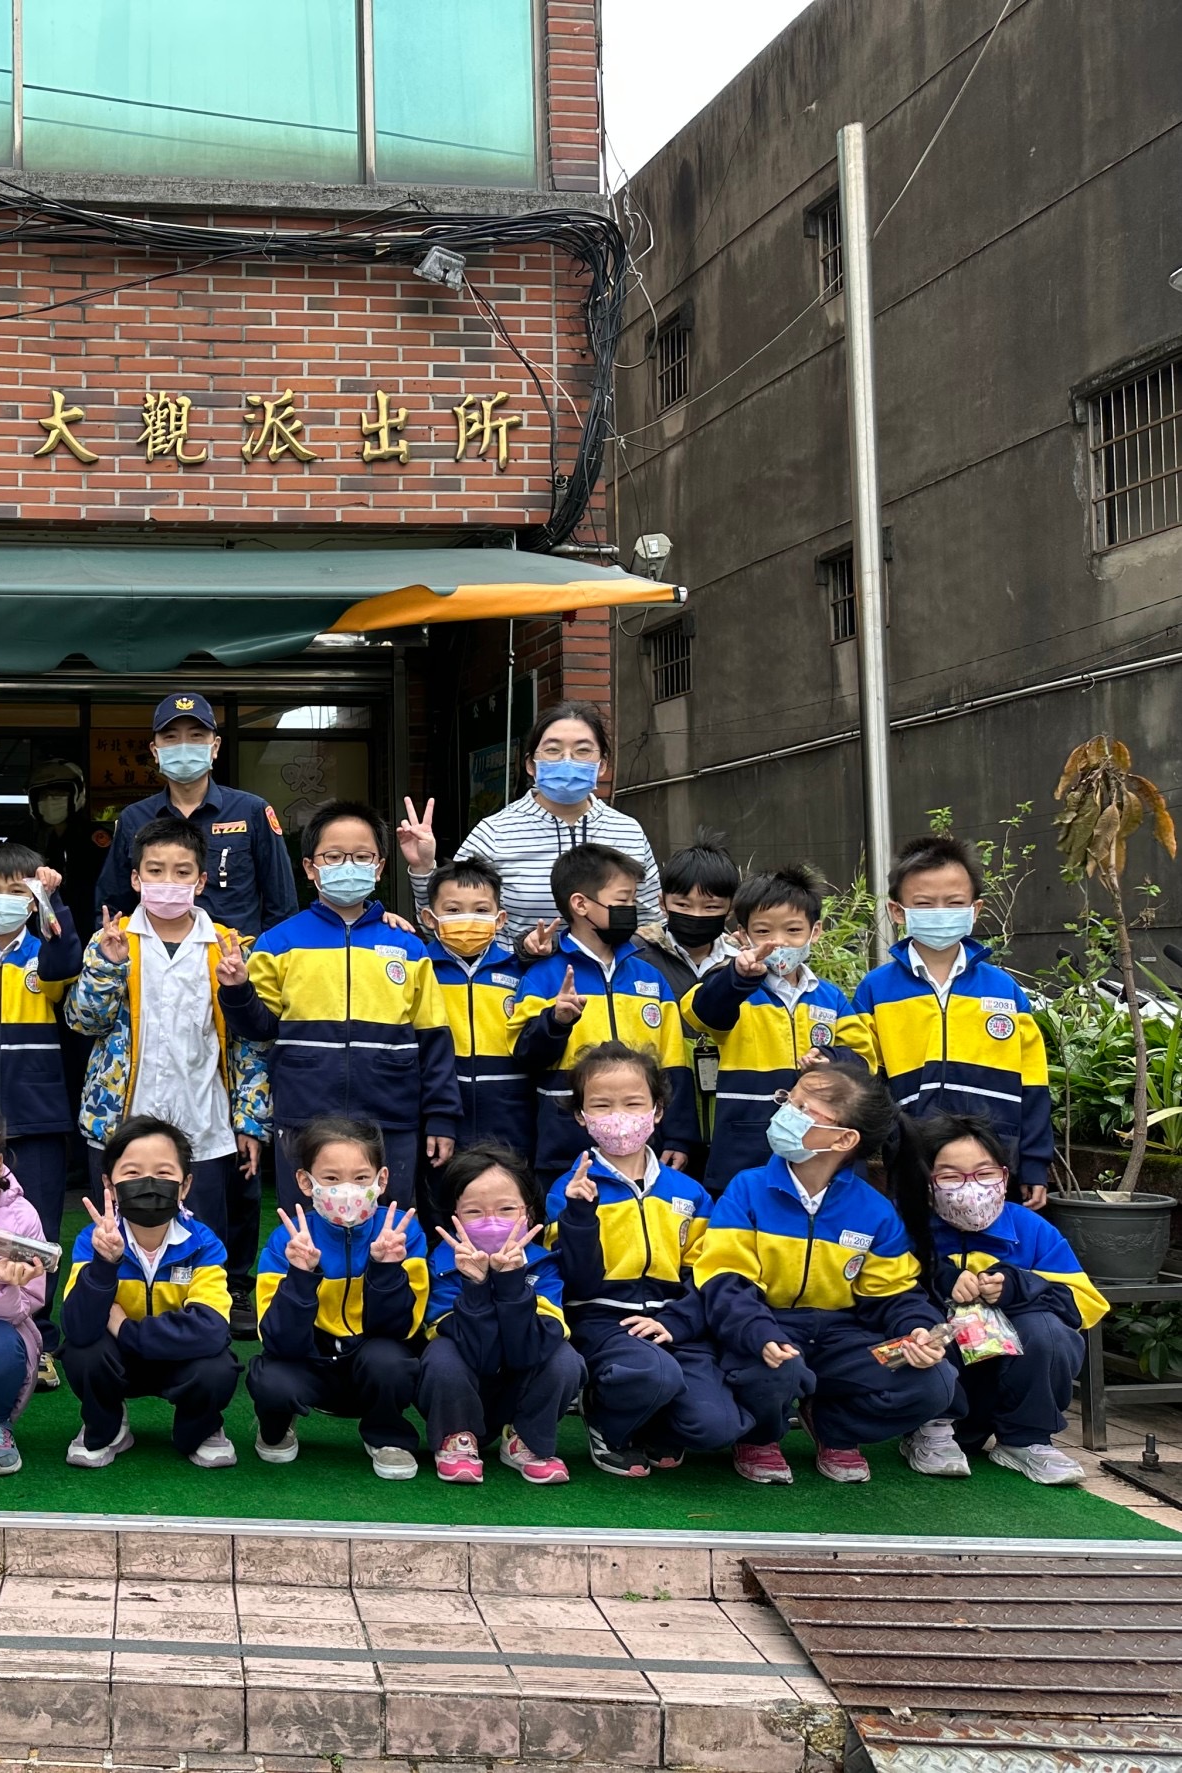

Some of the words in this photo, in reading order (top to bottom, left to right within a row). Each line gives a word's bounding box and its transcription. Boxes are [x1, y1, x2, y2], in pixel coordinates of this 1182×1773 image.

[34, 388, 523, 472] 大觀派出所
[993, 1000, 1015, 1010] 2031
[854, 1235, 871, 1247] 203
